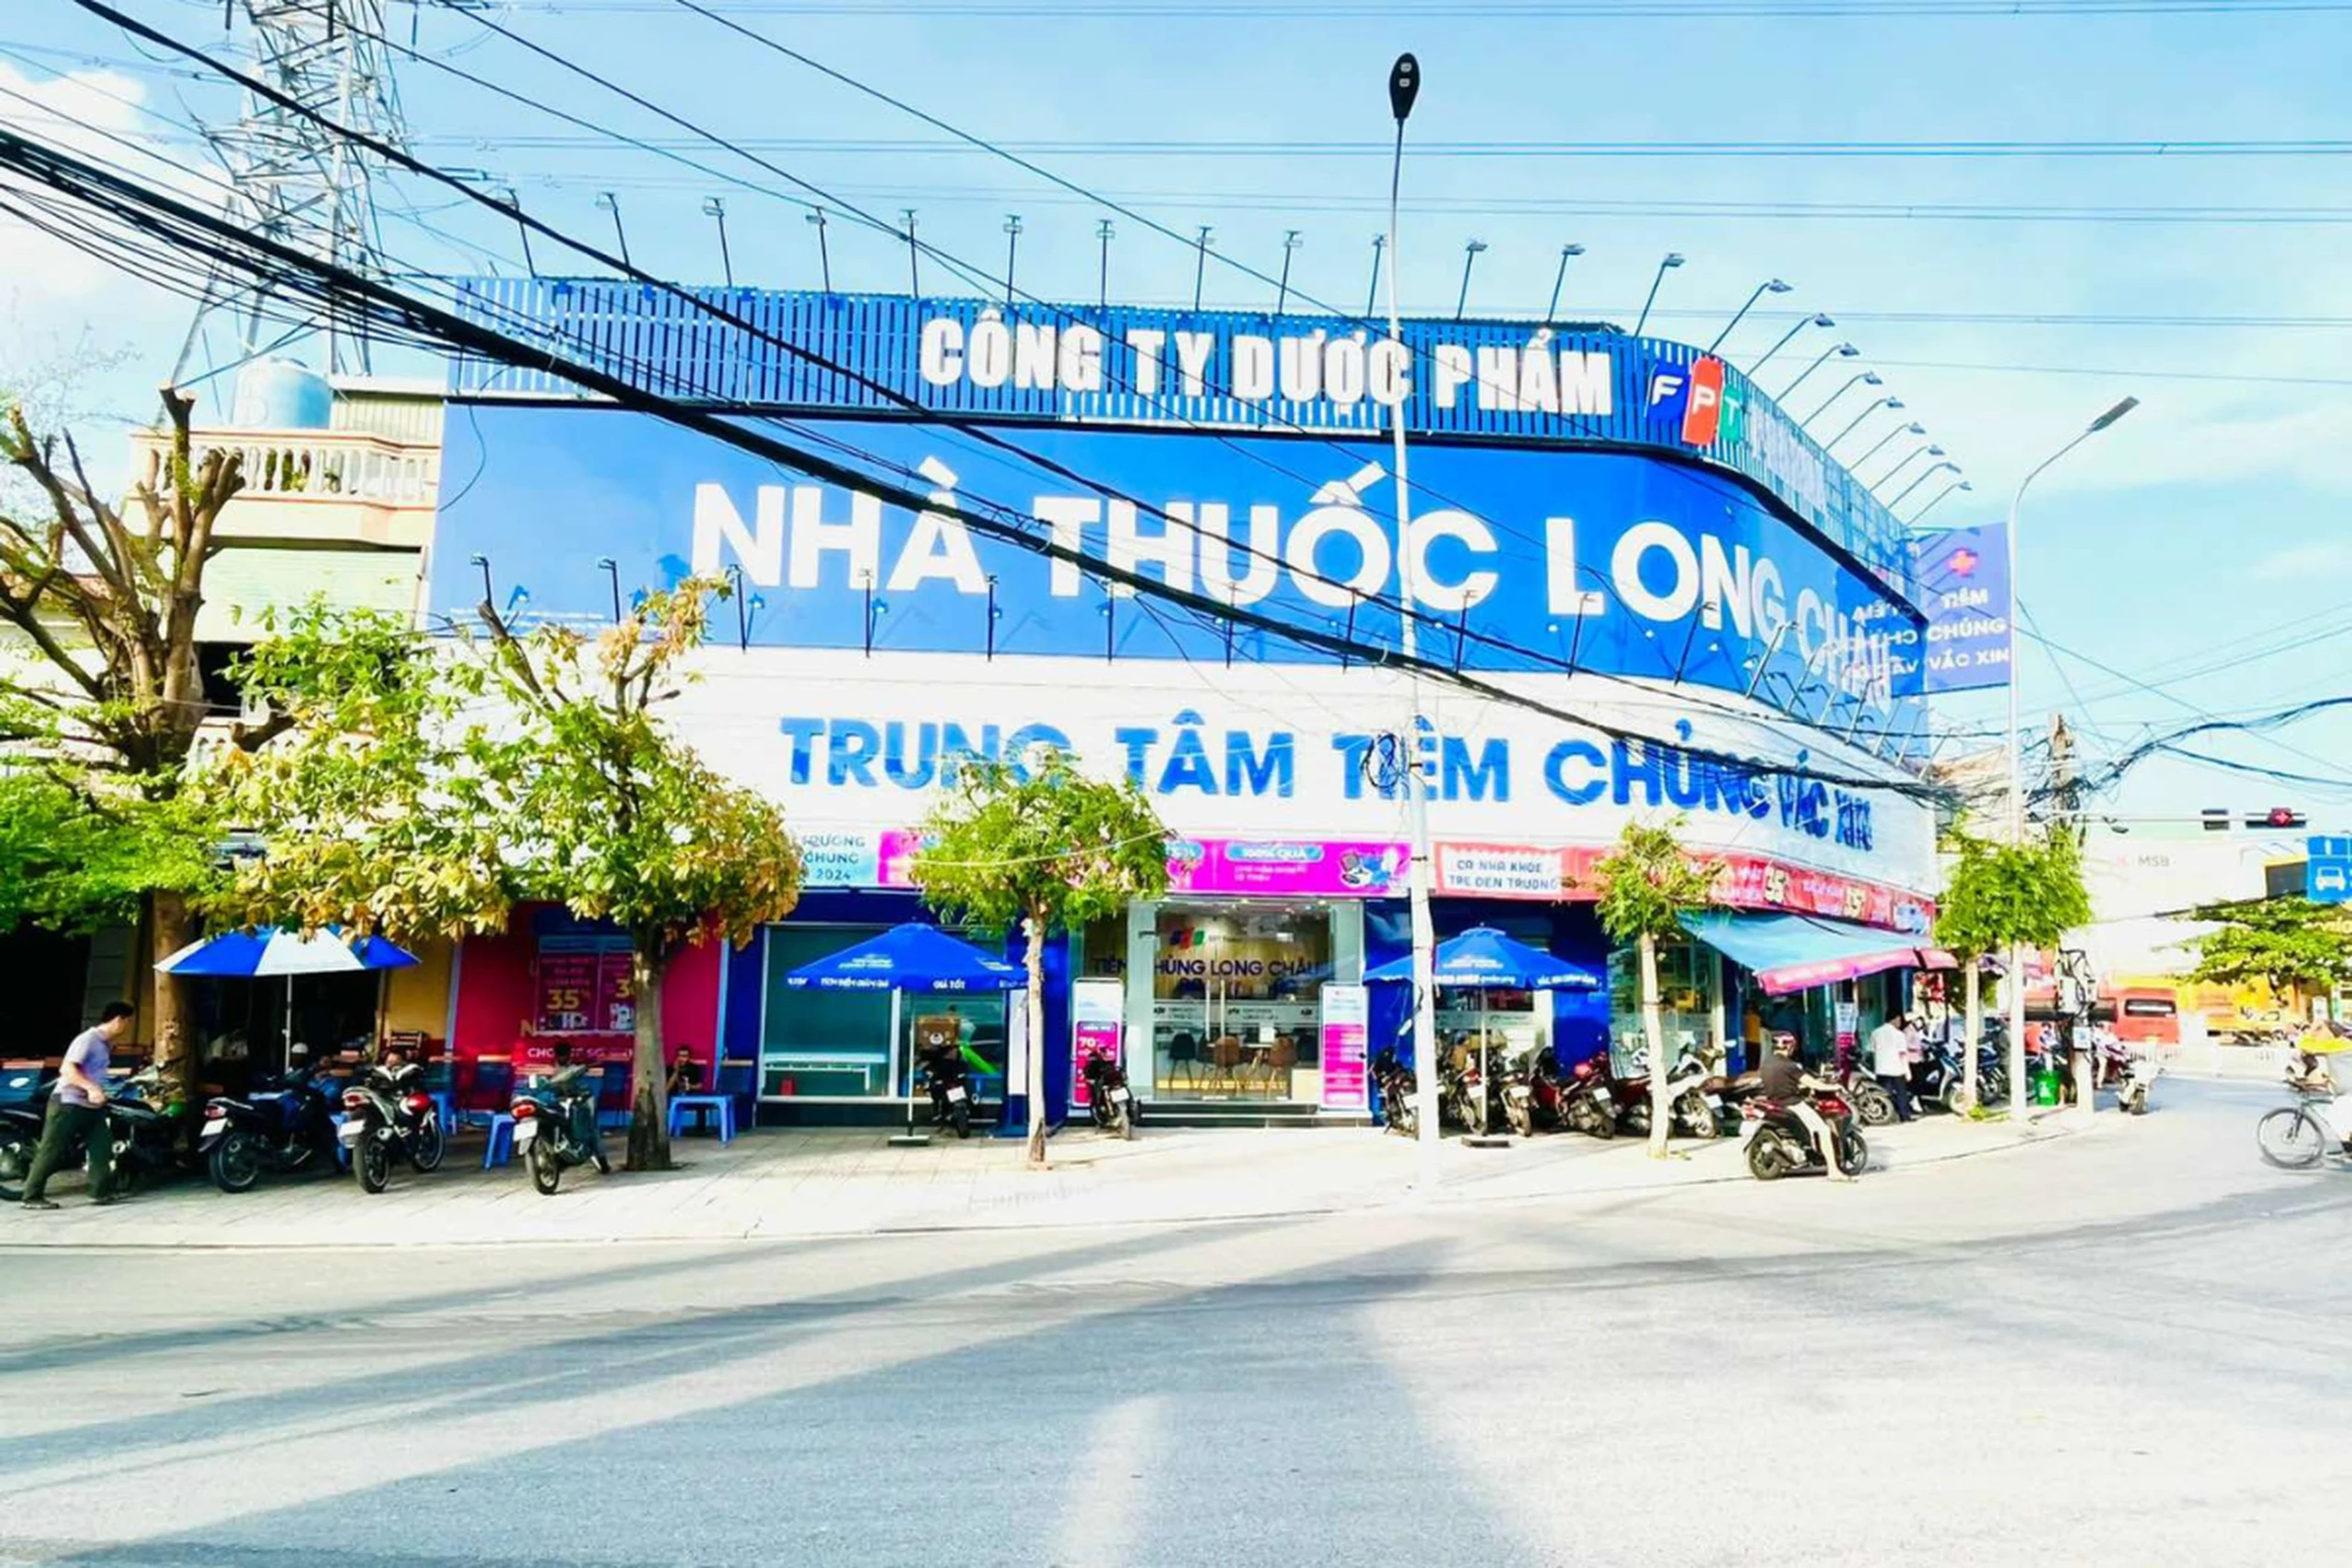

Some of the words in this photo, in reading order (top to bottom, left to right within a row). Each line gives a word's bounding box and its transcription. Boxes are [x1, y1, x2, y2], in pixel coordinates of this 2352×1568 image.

[920, 306, 1102, 392] CÔNG
[1126, 329, 1216, 398] TY
[1232, 329, 1412, 417] DƯỢC
[1435, 325, 1612, 415] PHẨM
[1651, 375, 1744, 428] FPT
[690, 456, 988, 592] NHÀ
[1033, 461, 1499, 611] THUỐC
[1545, 517, 1786, 643] LONG
[1976, 647, 2009, 666] XIN
[1114, 707, 1294, 798] TÂM
[1210, 959, 1263, 976] LONG
